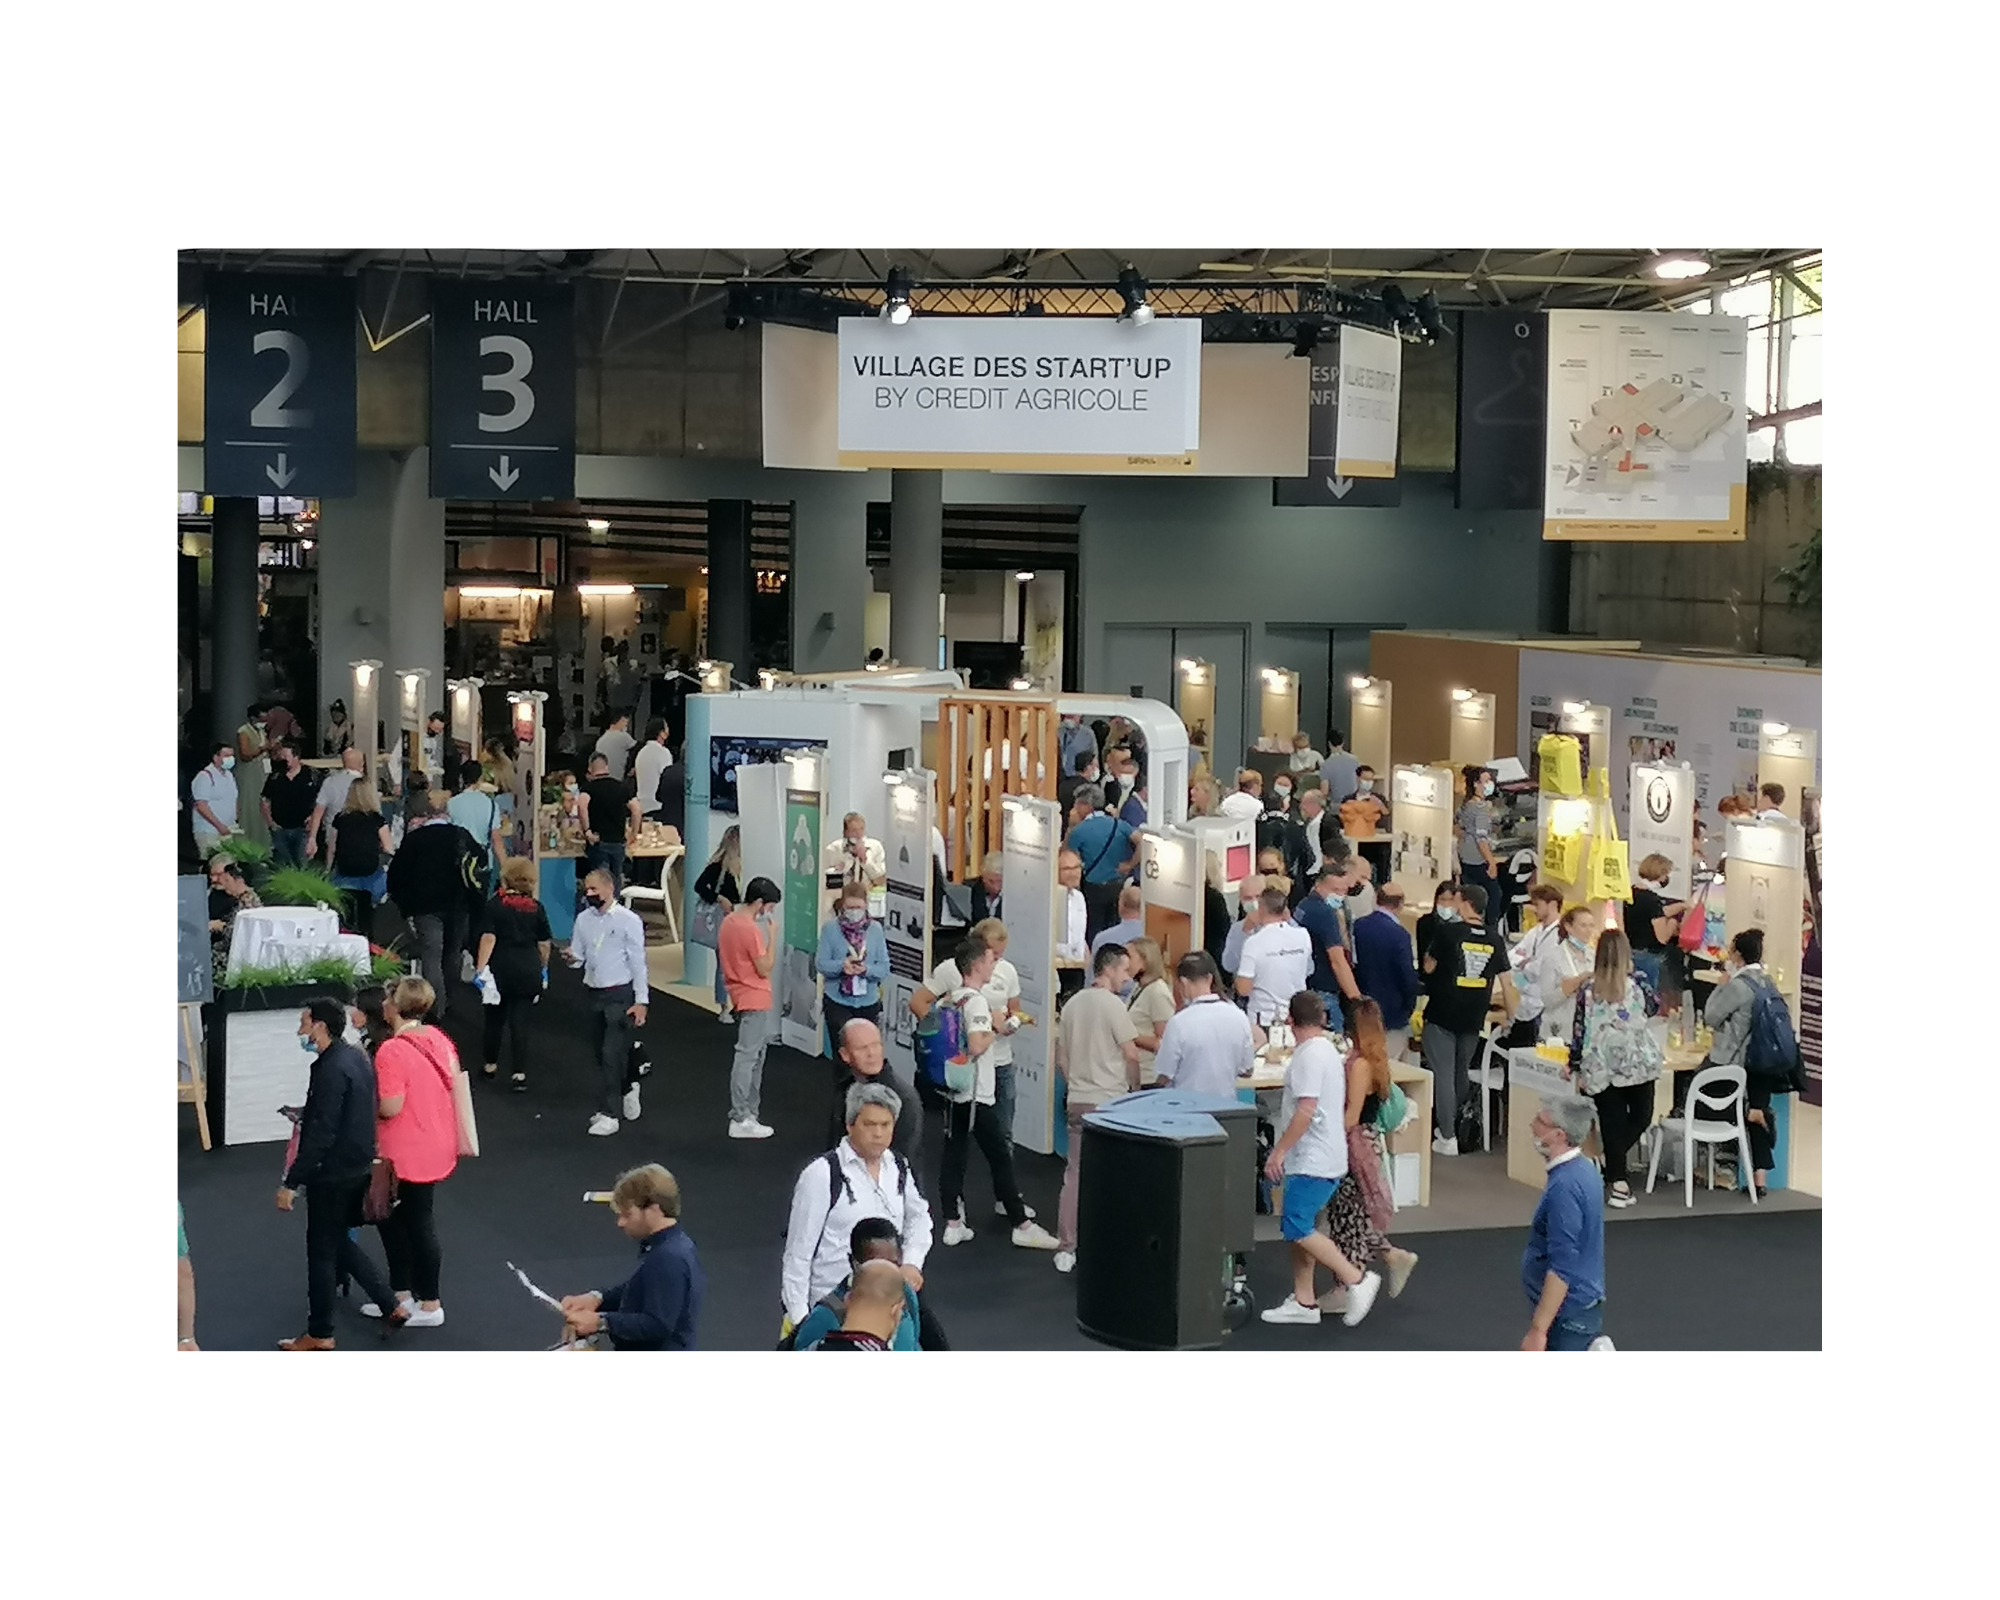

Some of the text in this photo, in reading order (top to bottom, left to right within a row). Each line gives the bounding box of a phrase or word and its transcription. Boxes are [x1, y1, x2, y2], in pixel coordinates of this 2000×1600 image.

[250, 293, 298, 317] HA
[474, 299, 539, 324] HALL
[251, 329, 314, 428] 2
[853, 355, 1172, 379] VILLAGE DES START'UP
[1311, 366, 1340, 383] ESP
[478, 334, 536, 433] 3
[875, 386, 1149, 412] BY CREDIT AGRICOLE
[1310, 389, 1339, 406] NFL
